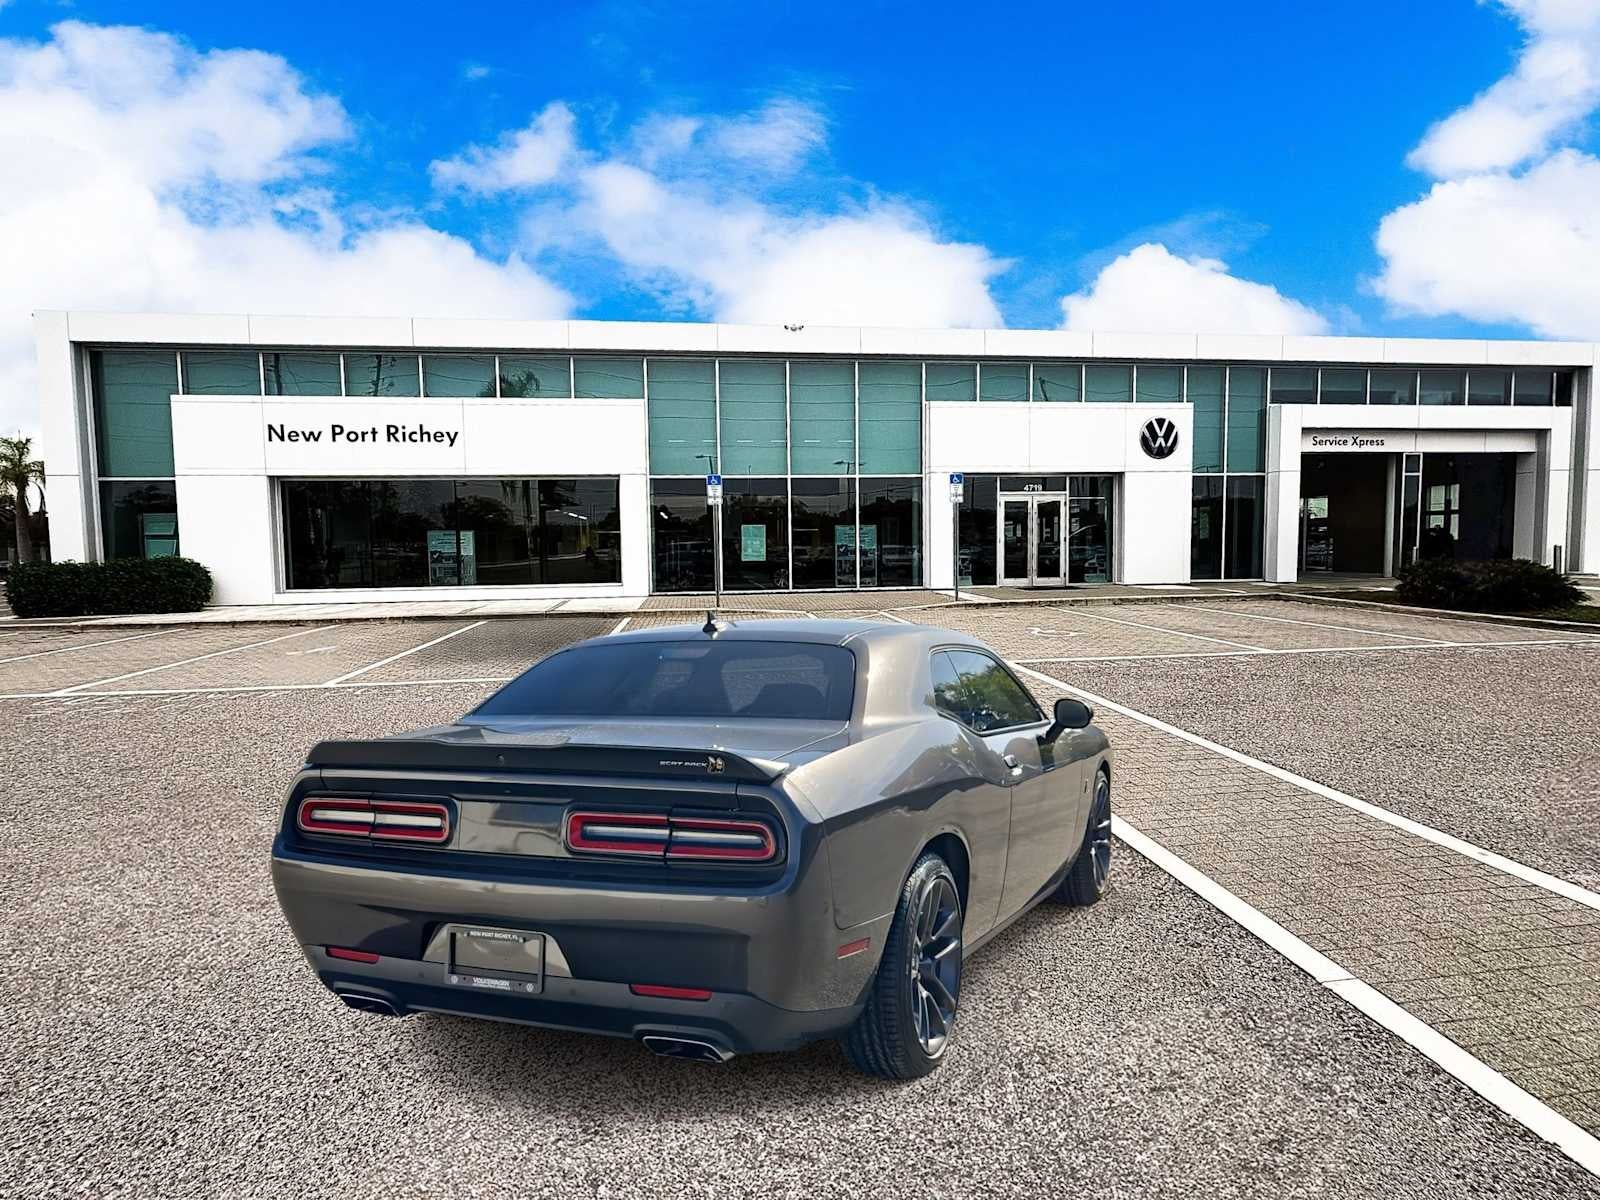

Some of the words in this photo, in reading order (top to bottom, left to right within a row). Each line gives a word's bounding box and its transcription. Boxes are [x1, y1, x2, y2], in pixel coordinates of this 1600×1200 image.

[267, 423, 323, 443] New
[331, 424, 379, 443] Port
[386, 424, 459, 448] Richey
[1312, 435, 1348, 446] Service
[1351, 436, 1385, 448] Xpress
